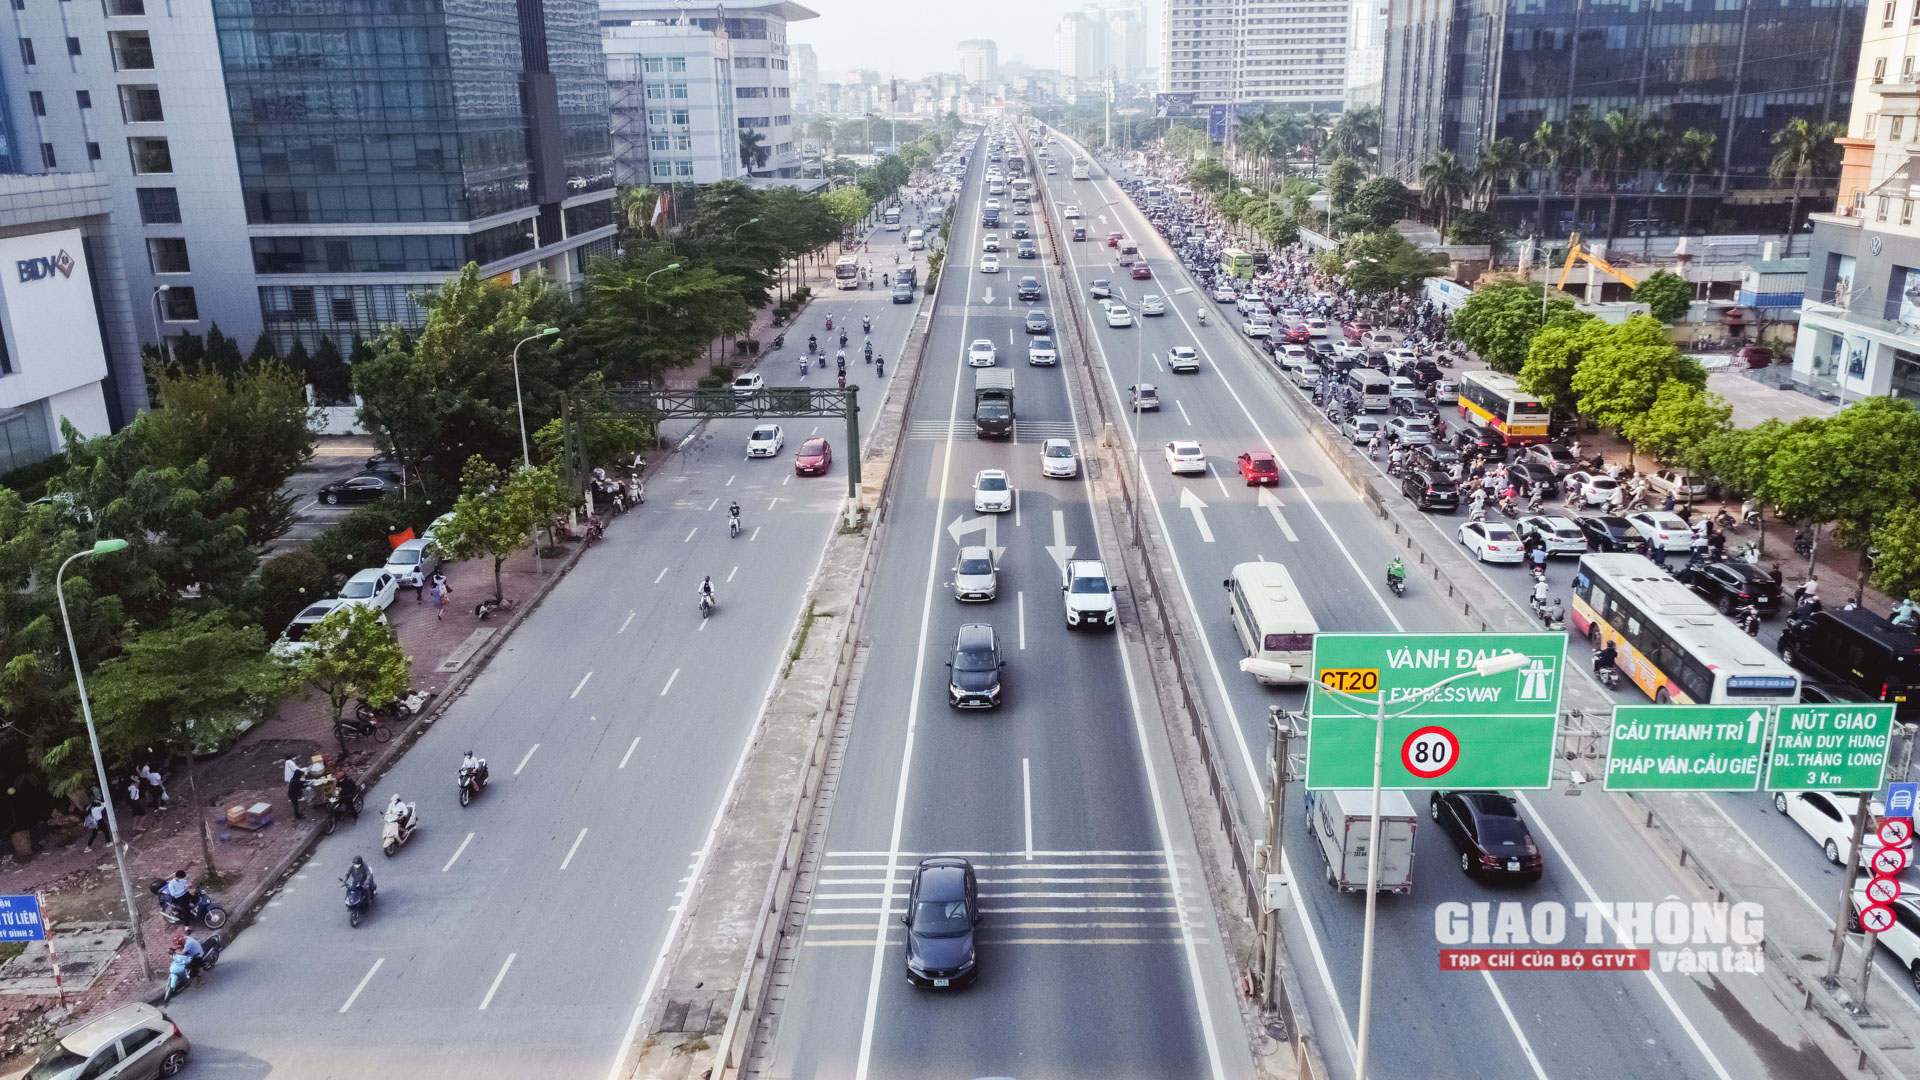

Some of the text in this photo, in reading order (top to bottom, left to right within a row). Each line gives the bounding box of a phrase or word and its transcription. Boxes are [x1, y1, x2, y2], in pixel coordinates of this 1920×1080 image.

[16, 255, 56, 283] BIDV
[1386, 646, 1450, 669] VÀNH
[1321, 671, 1377, 691] CT.20
[1391, 687, 1502, 703] EXPRESSWAY
[1791, 709, 1877, 730] NÚT GIAO
[1615, 719, 1744, 740] CẦU THANH TRÌ
[1777, 731, 1886, 748] TRẦN DUY HƯNG
[1415, 741, 1445, 763] 80
[1774, 751, 1883, 766] ĐL. THĂNG LONG
[1609, 755, 1655, 774] PHÁP
[1806, 772, 1842, 784] 3 Km
[1, 910, 38, 925] TỪ LIÊM
[9, 929, 27, 938] ĐÌNH
